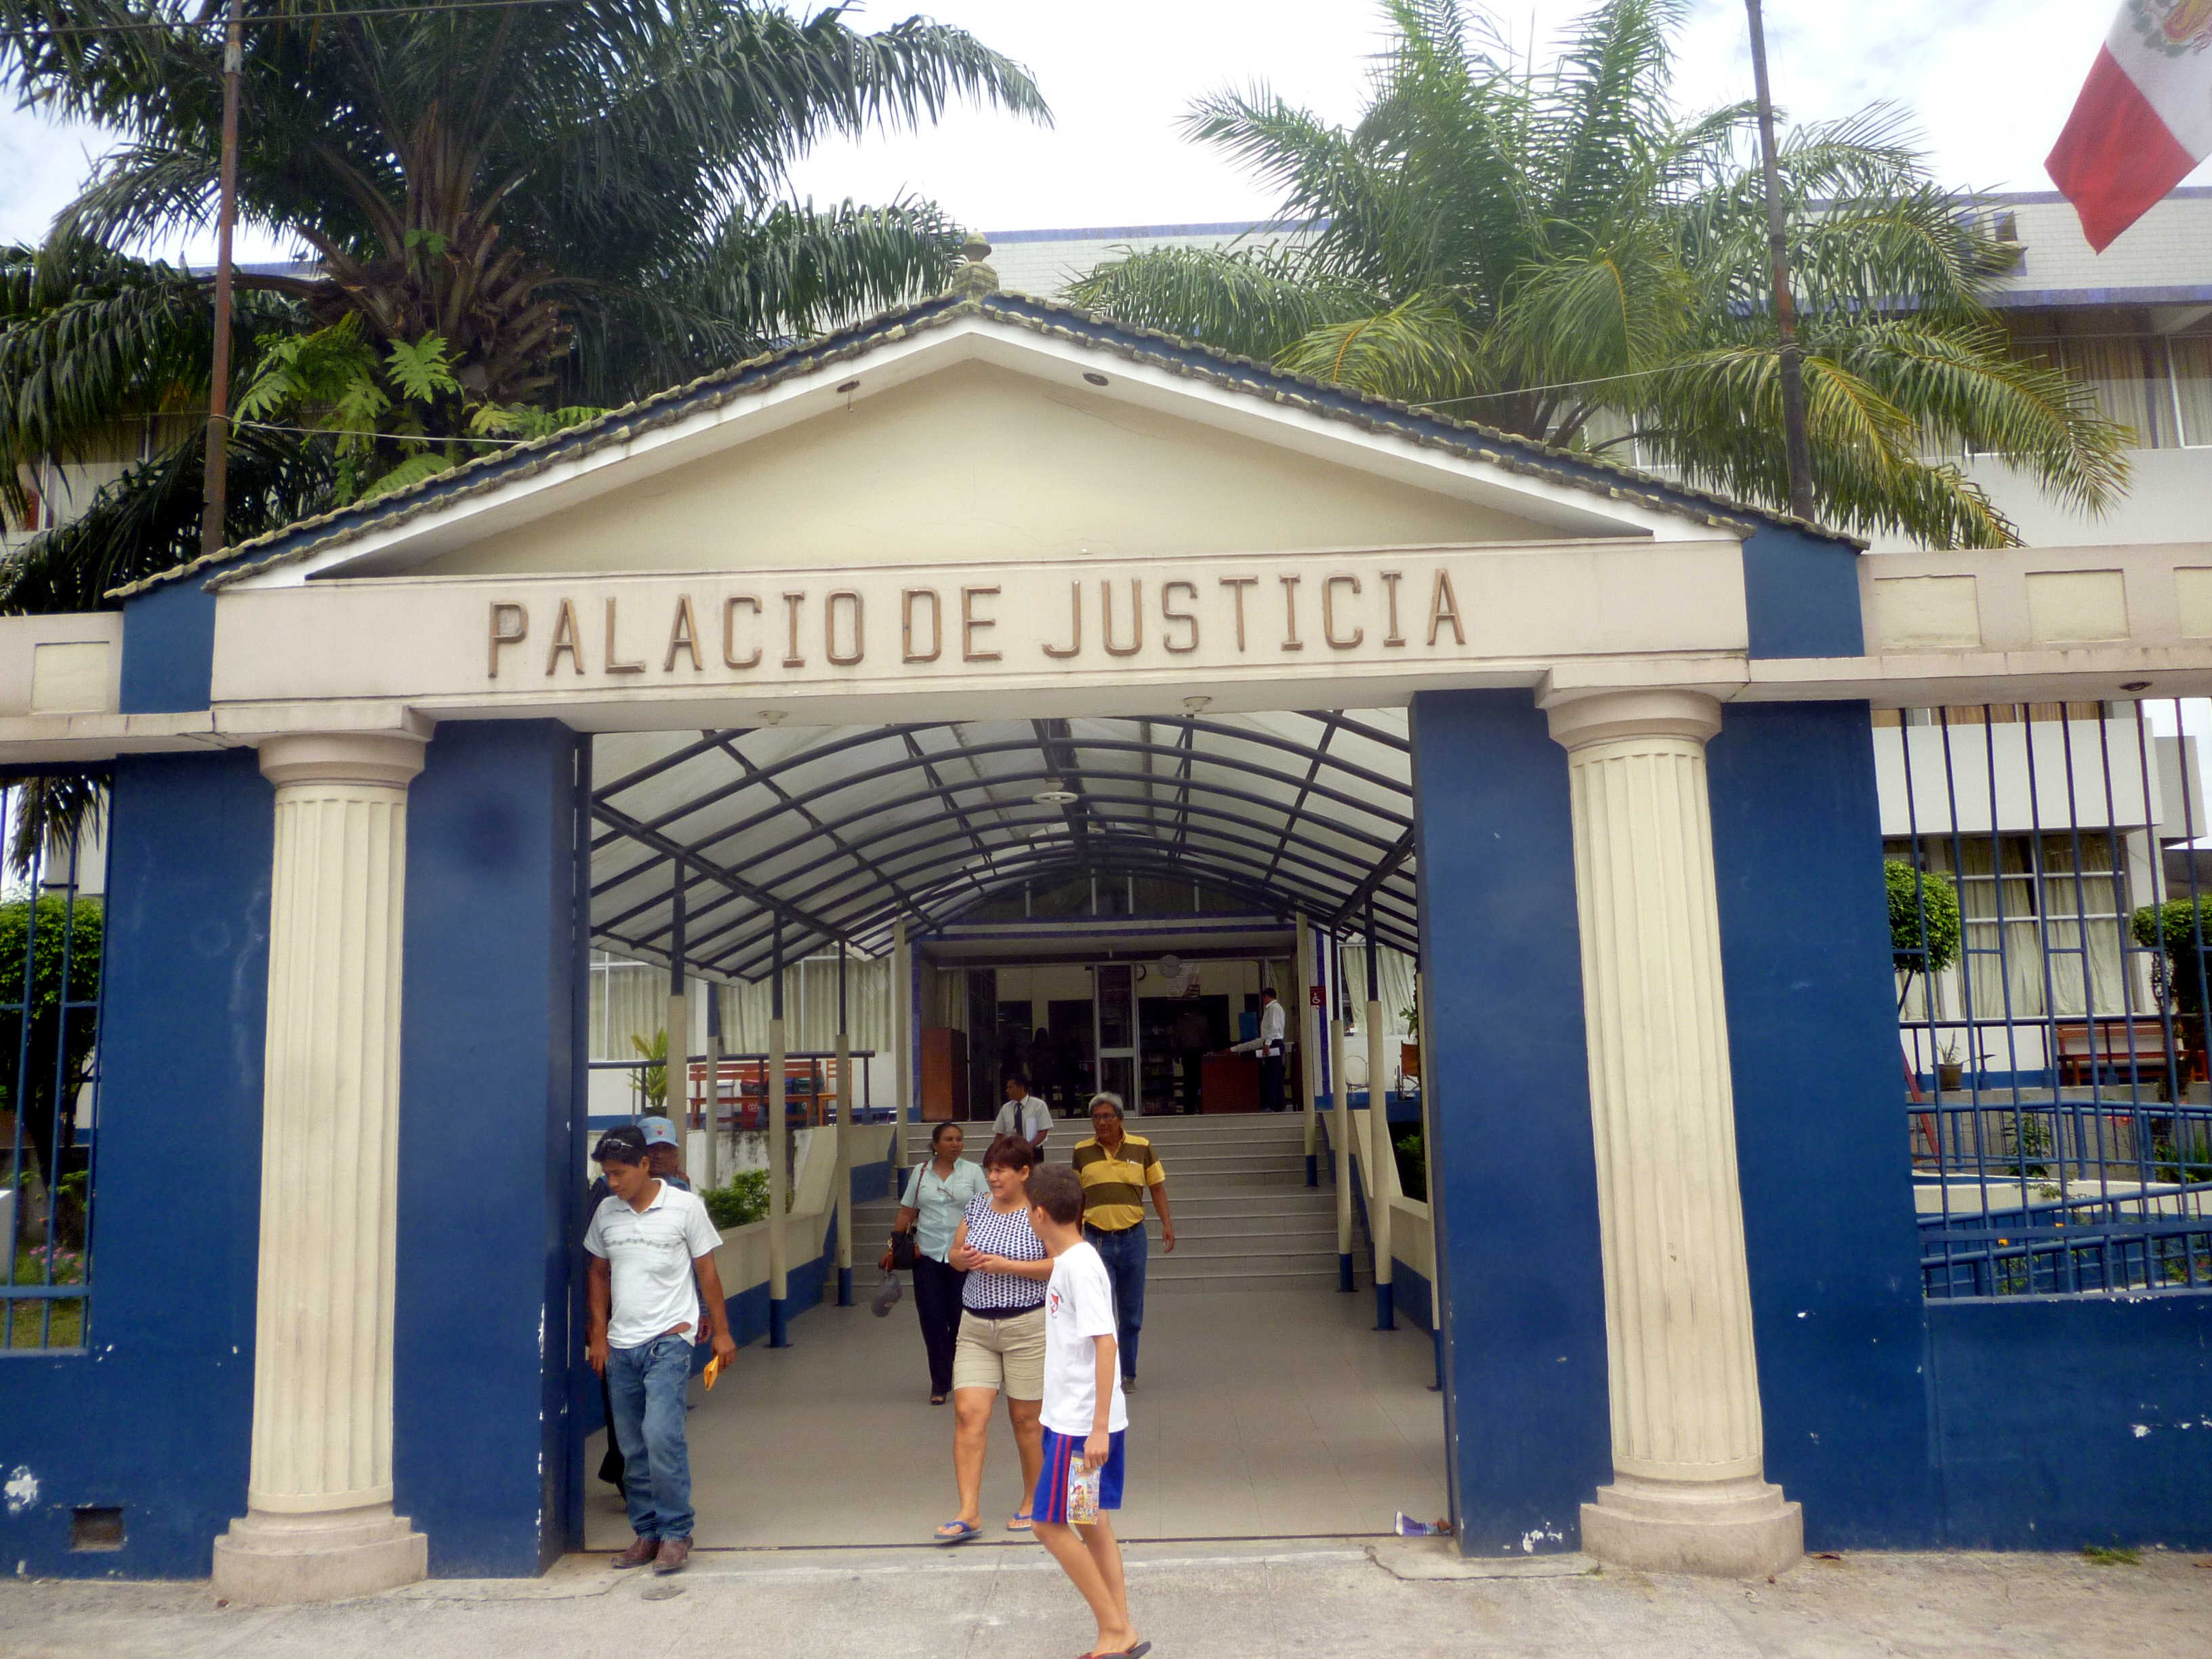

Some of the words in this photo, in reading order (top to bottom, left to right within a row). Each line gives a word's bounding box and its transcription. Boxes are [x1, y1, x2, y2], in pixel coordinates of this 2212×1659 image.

[487, 590, 865, 678] PALACIO
[901, 584, 1003, 665] DE
[1041, 568, 1467, 658] JUSTICIA
